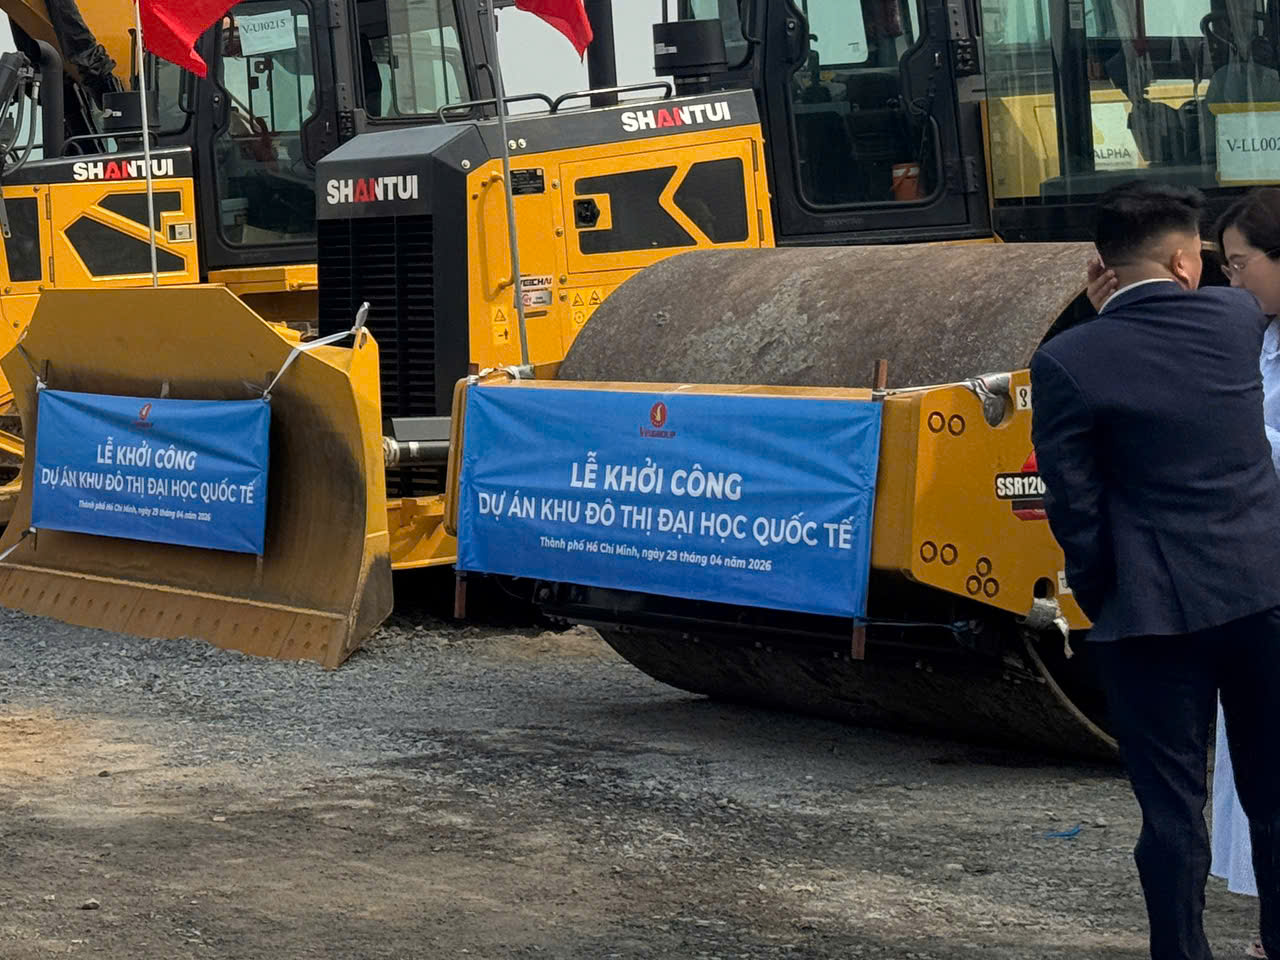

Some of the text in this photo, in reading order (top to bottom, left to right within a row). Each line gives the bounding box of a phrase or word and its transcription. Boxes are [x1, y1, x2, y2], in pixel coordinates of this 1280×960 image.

[620, 101, 731, 132] SHANTUI
[73, 158, 174, 181] SHANTUI
[326, 174, 419, 205] SHANTUI
[97, 436, 198, 471] LỄ KHỞI CÔNG
[41, 467, 256, 504] DỰ ÁN KHU ĐÔ THỊ ĐẠI HỌC QUỐC TẾ
[570, 451, 743, 501] LỄ KHỞI CÔNG
[478, 490, 855, 549] DỰ ÁN KHU ĐÔ THỊ ĐẠI HỌC QUỐC TẾ
[540, 536, 566, 550] Thành
[567, 539, 585, 553] phố
[600, 543, 615, 555] Chí
[641, 547, 664, 562] ngày
[666, 549, 678, 560] 29
[679, 551, 708, 567] tháng
[709, 554, 722, 566] 04
[724, 555, 746, 569] năm
[747, 558, 772, 572] 2026
